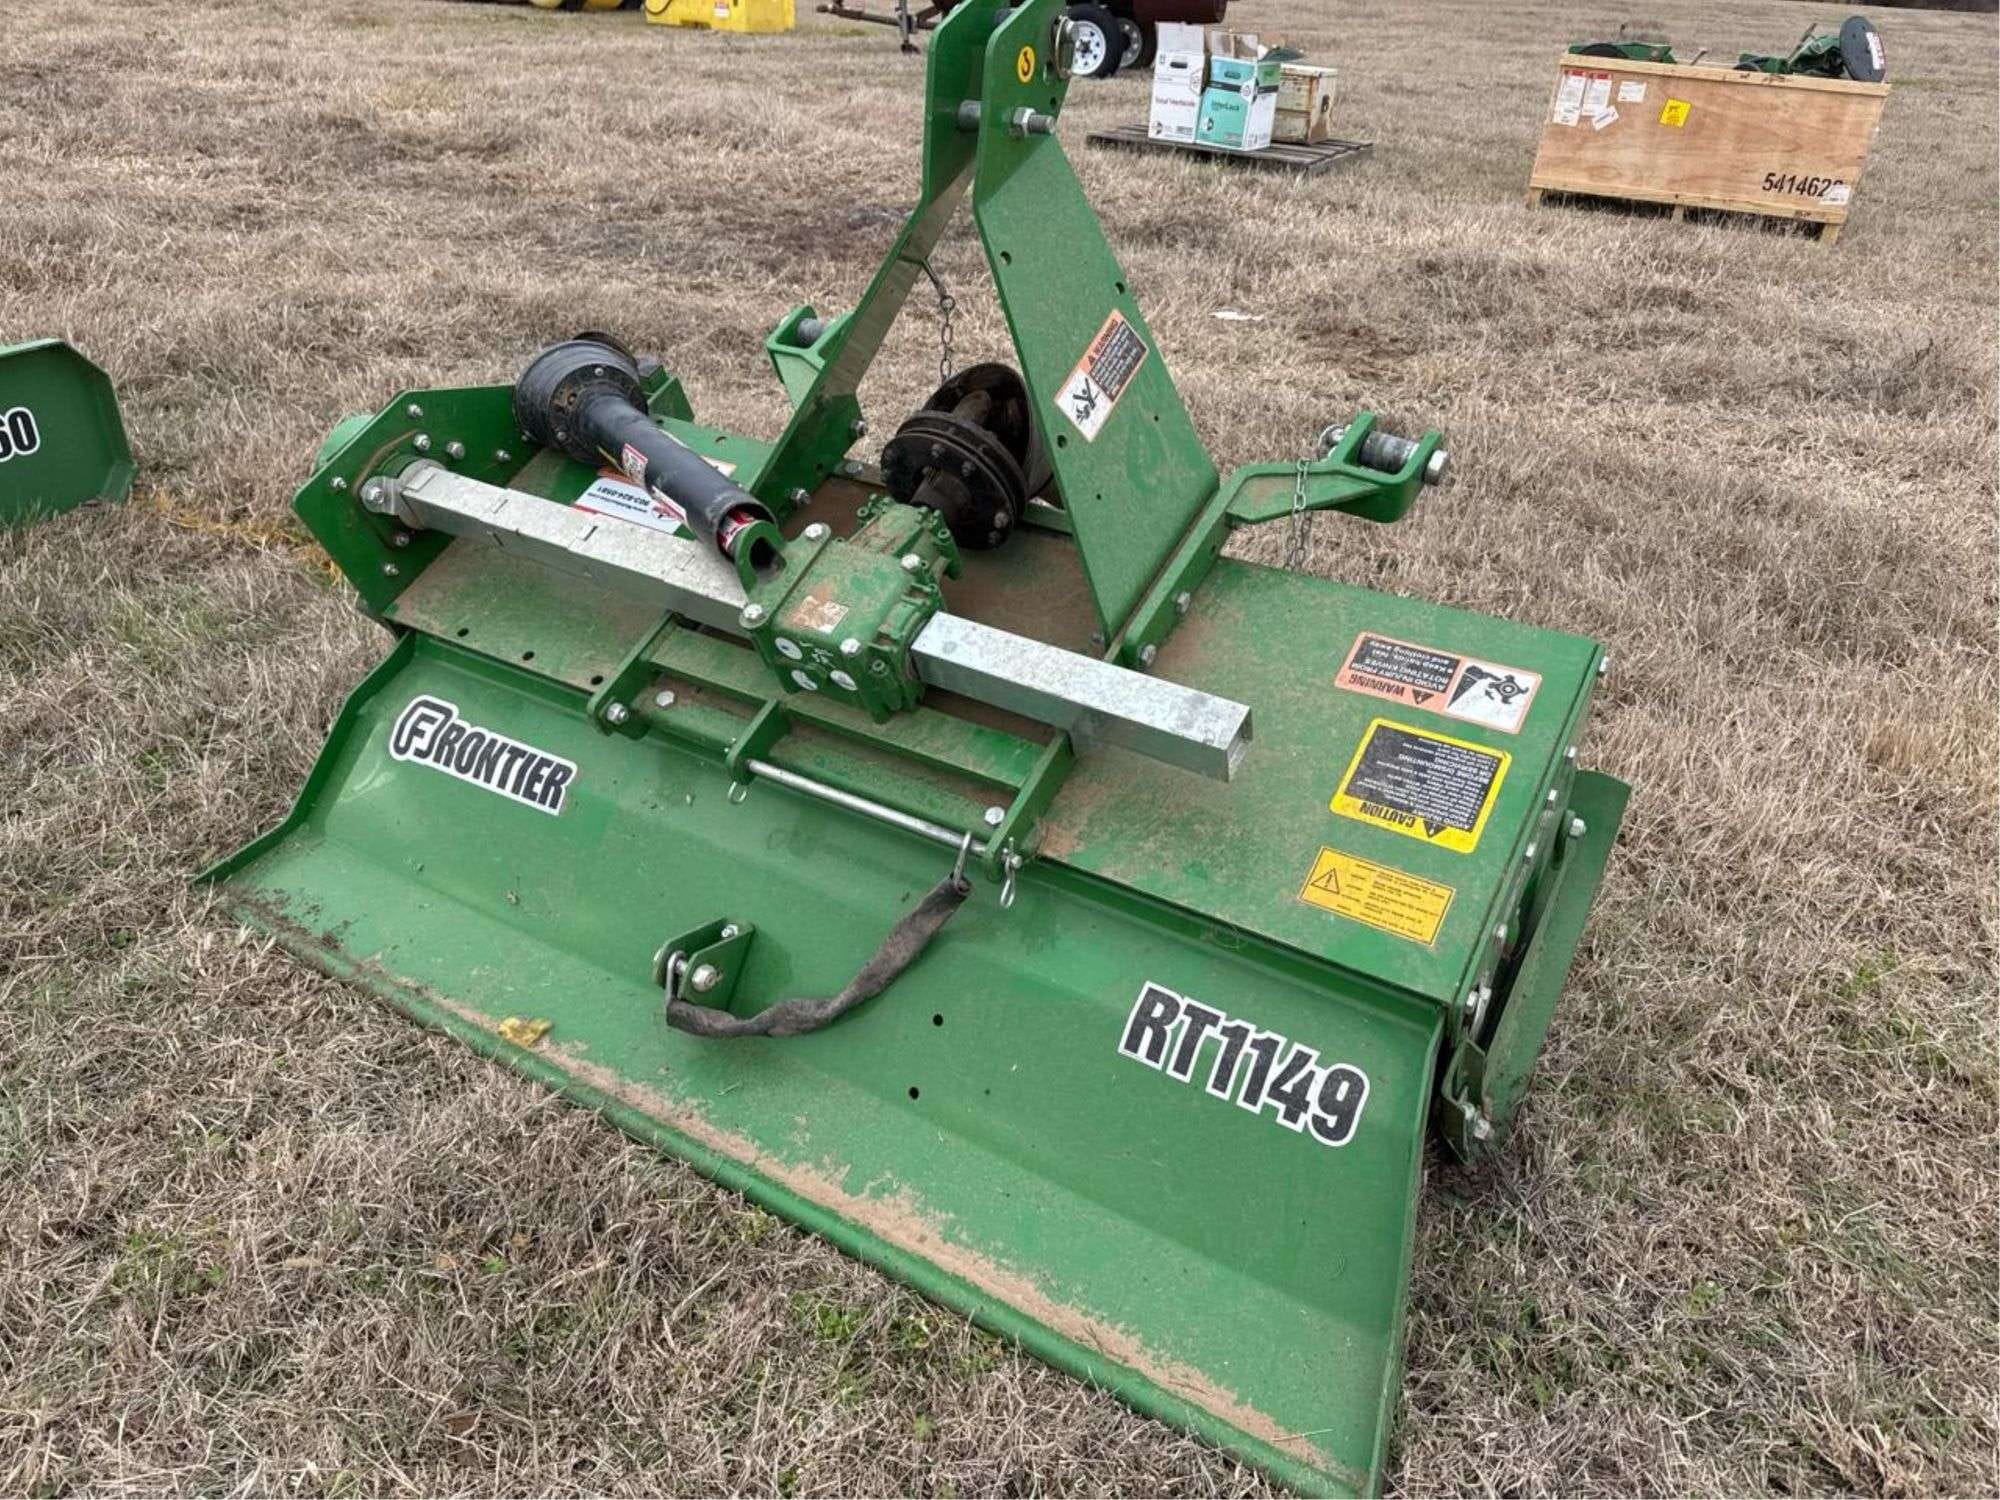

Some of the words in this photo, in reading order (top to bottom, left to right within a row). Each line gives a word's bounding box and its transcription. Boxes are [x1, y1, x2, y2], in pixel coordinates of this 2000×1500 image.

[1348, 672, 1406, 697] WARNING
[1378, 668, 1413, 683] INJURY
[1399, 666, 1449, 685] ROTATING
[1413, 677, 1445, 692] AVOID
[393, 699, 573, 810] FRONTIER
[1358, 801, 1417, 828] CAUTION
[1124, 988, 1366, 1142] RT1149
